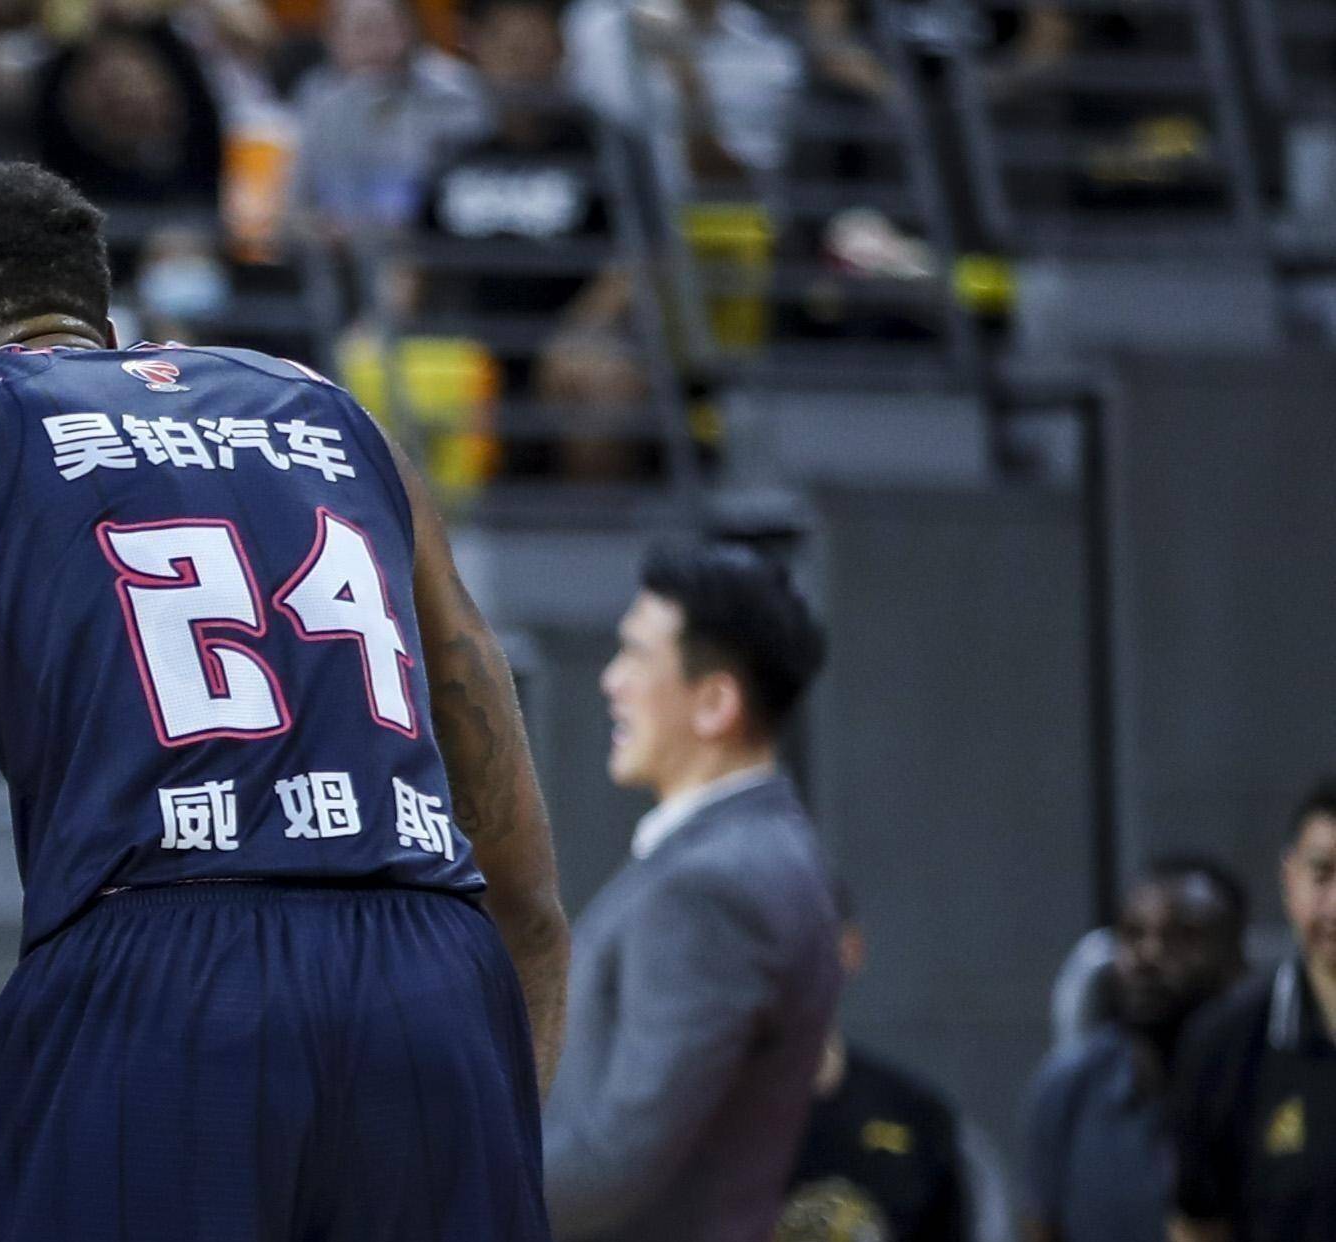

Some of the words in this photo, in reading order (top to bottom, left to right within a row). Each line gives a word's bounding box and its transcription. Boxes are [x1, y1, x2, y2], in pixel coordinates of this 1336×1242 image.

[41, 412, 357, 482] 昊铂汽车
[94, 505, 415, 748] 24
[157, 770, 456, 863] 威姆斯
